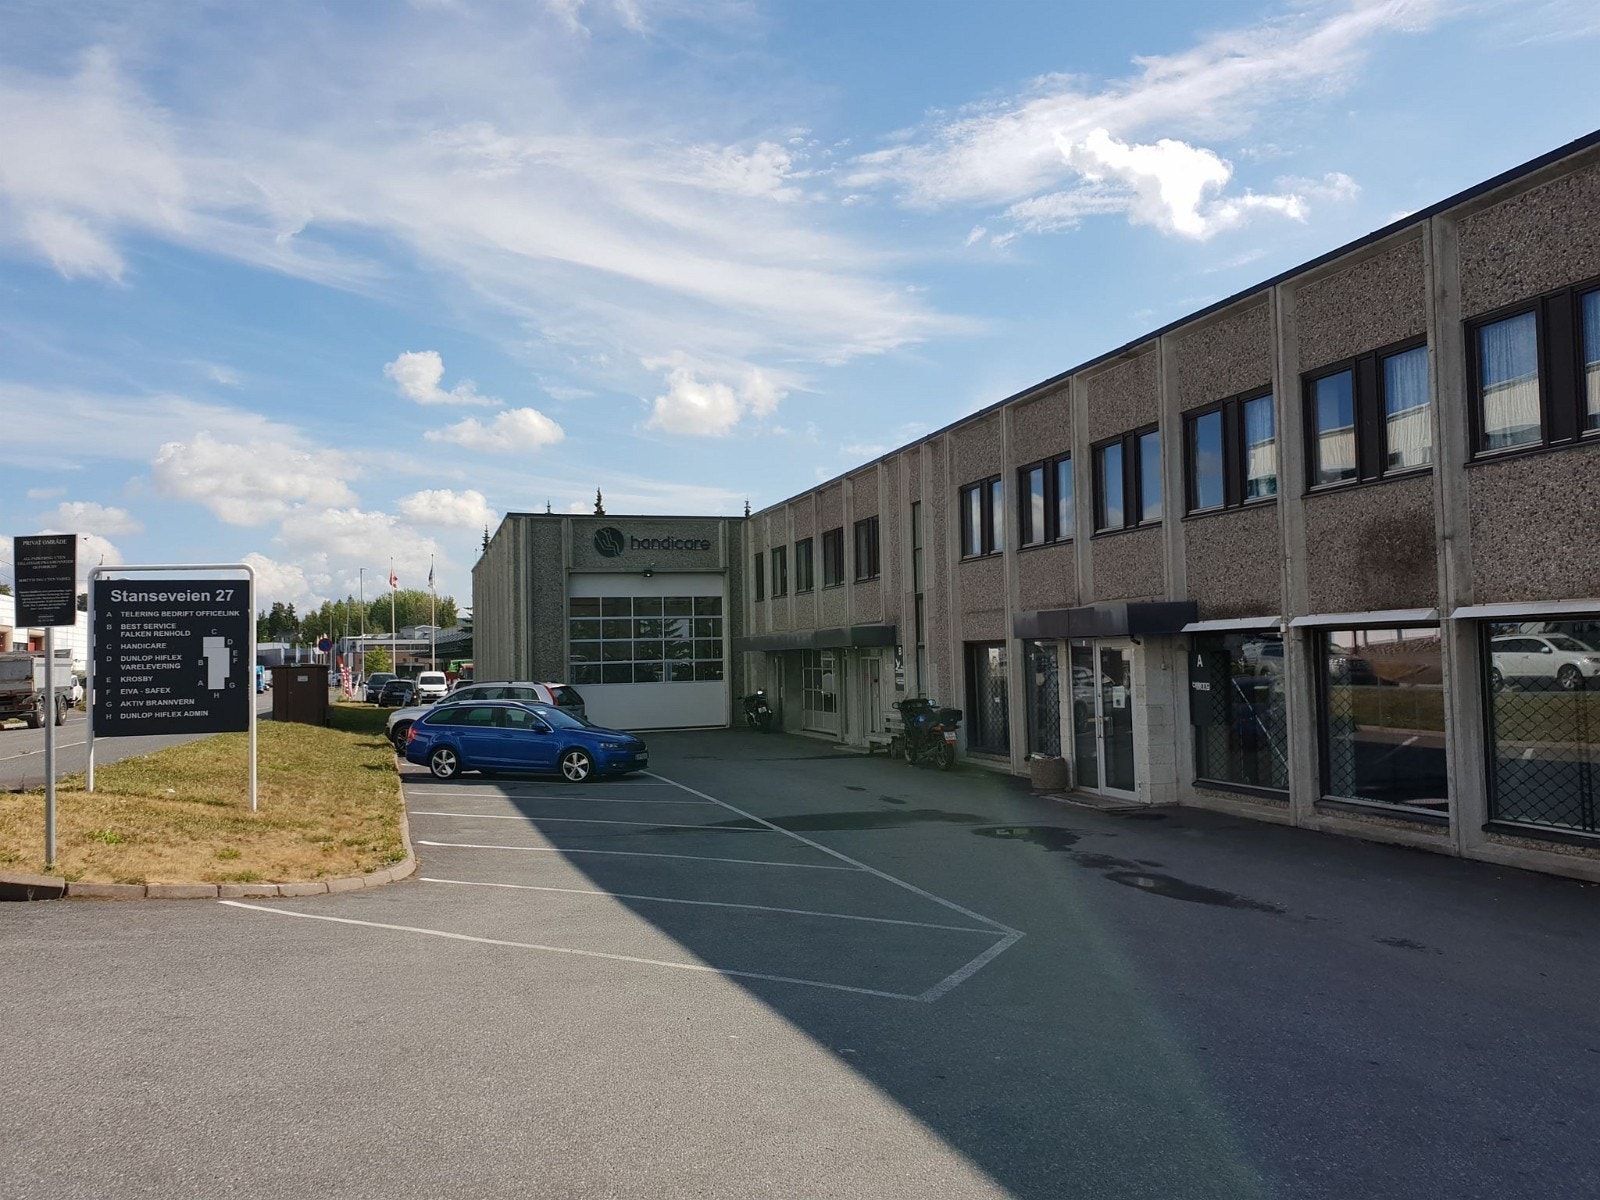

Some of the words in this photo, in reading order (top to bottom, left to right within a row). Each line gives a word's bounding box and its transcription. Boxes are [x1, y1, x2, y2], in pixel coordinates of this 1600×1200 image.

[630, 535, 711, 550] handicare
[110, 590, 211, 602] Stanseveien
[215, 590, 234, 602] 27
[120, 642, 167, 650] HANDICARE
[1197, 654, 1203, 667] A
[120, 662, 181, 671] VARELEVERING
[120, 675, 154, 683] KROSBY
[145, 687, 171, 695] SAFEX
[145, 698, 195, 706] BRANNVERN
[120, 712, 153, 720] DUNLOP
